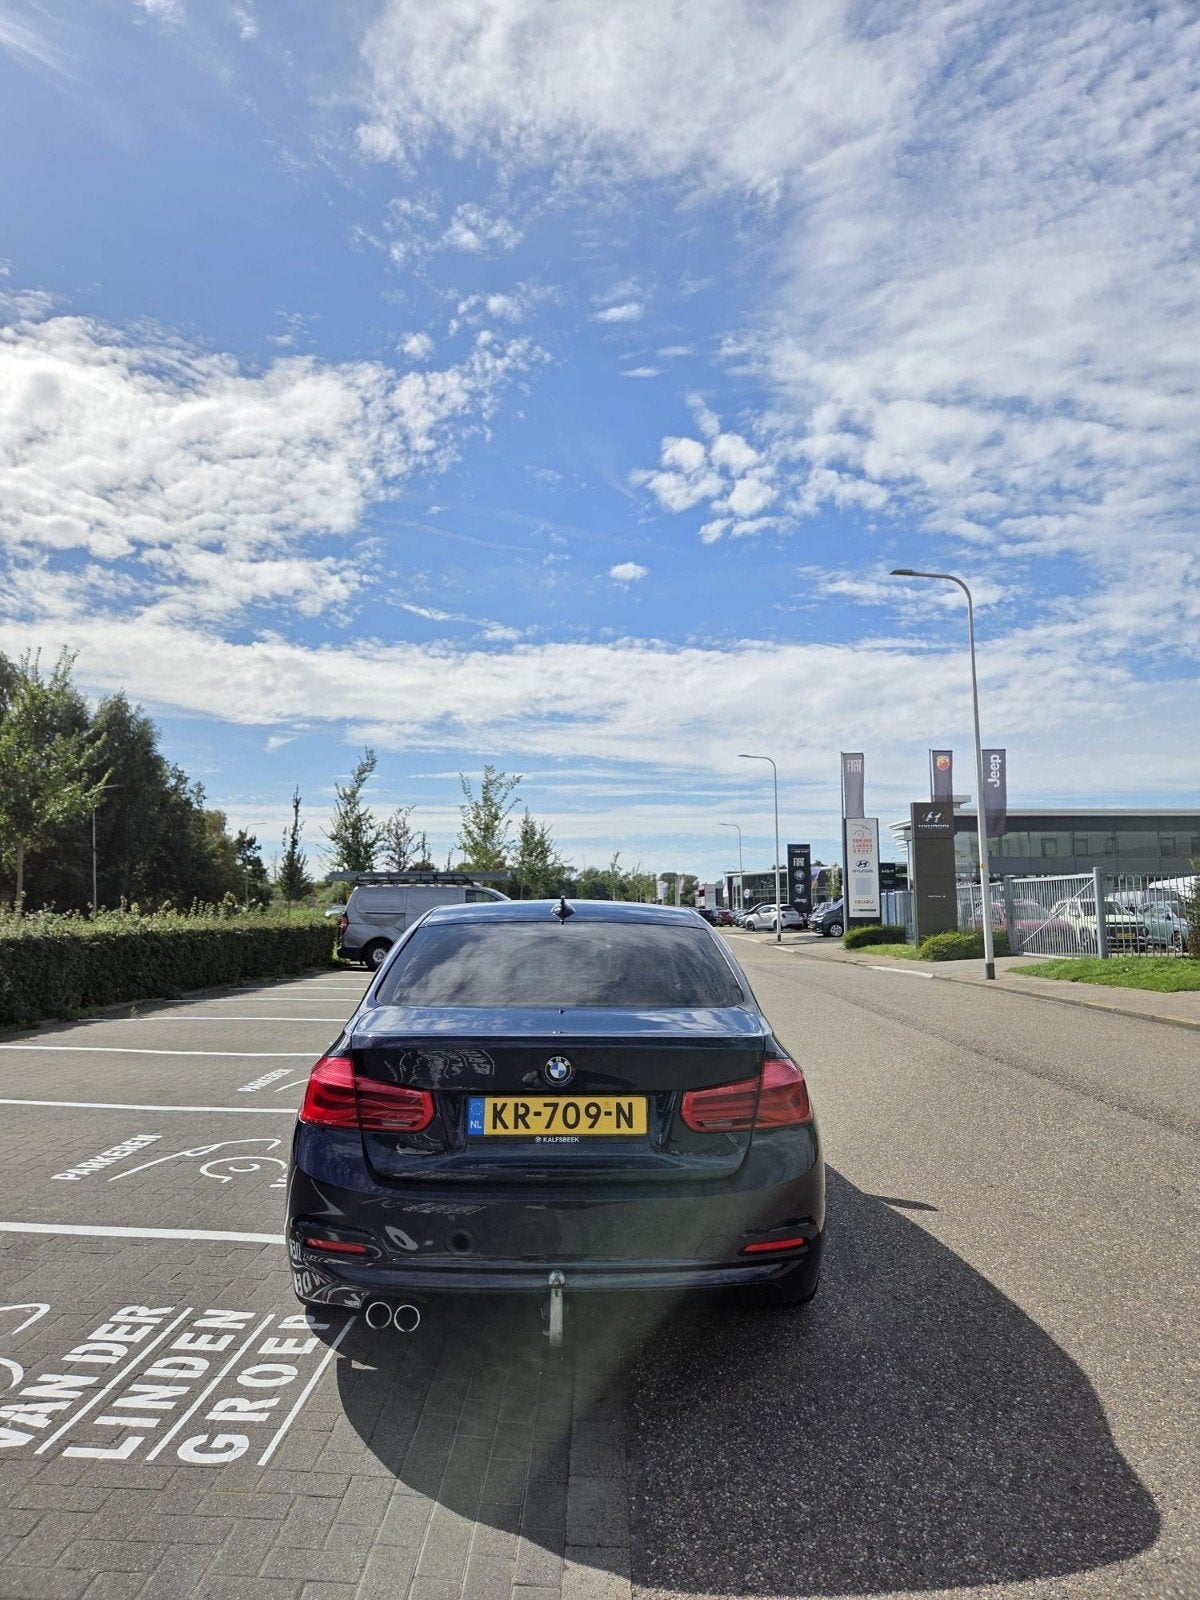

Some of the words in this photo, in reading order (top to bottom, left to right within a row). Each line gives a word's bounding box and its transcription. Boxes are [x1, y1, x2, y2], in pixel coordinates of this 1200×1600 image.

[847, 759, 862, 772] FIAT
[988, 754, 1001, 787] Jeep
[470, 1120, 482, 1129] NL
[492, 1102, 633, 1130] KR-709-N
[51, 1134, 163, 1181] PARKEREN
[62, 1308, 256, 1460] LINDEN
[177, 1314, 330, 1464] GROEP
